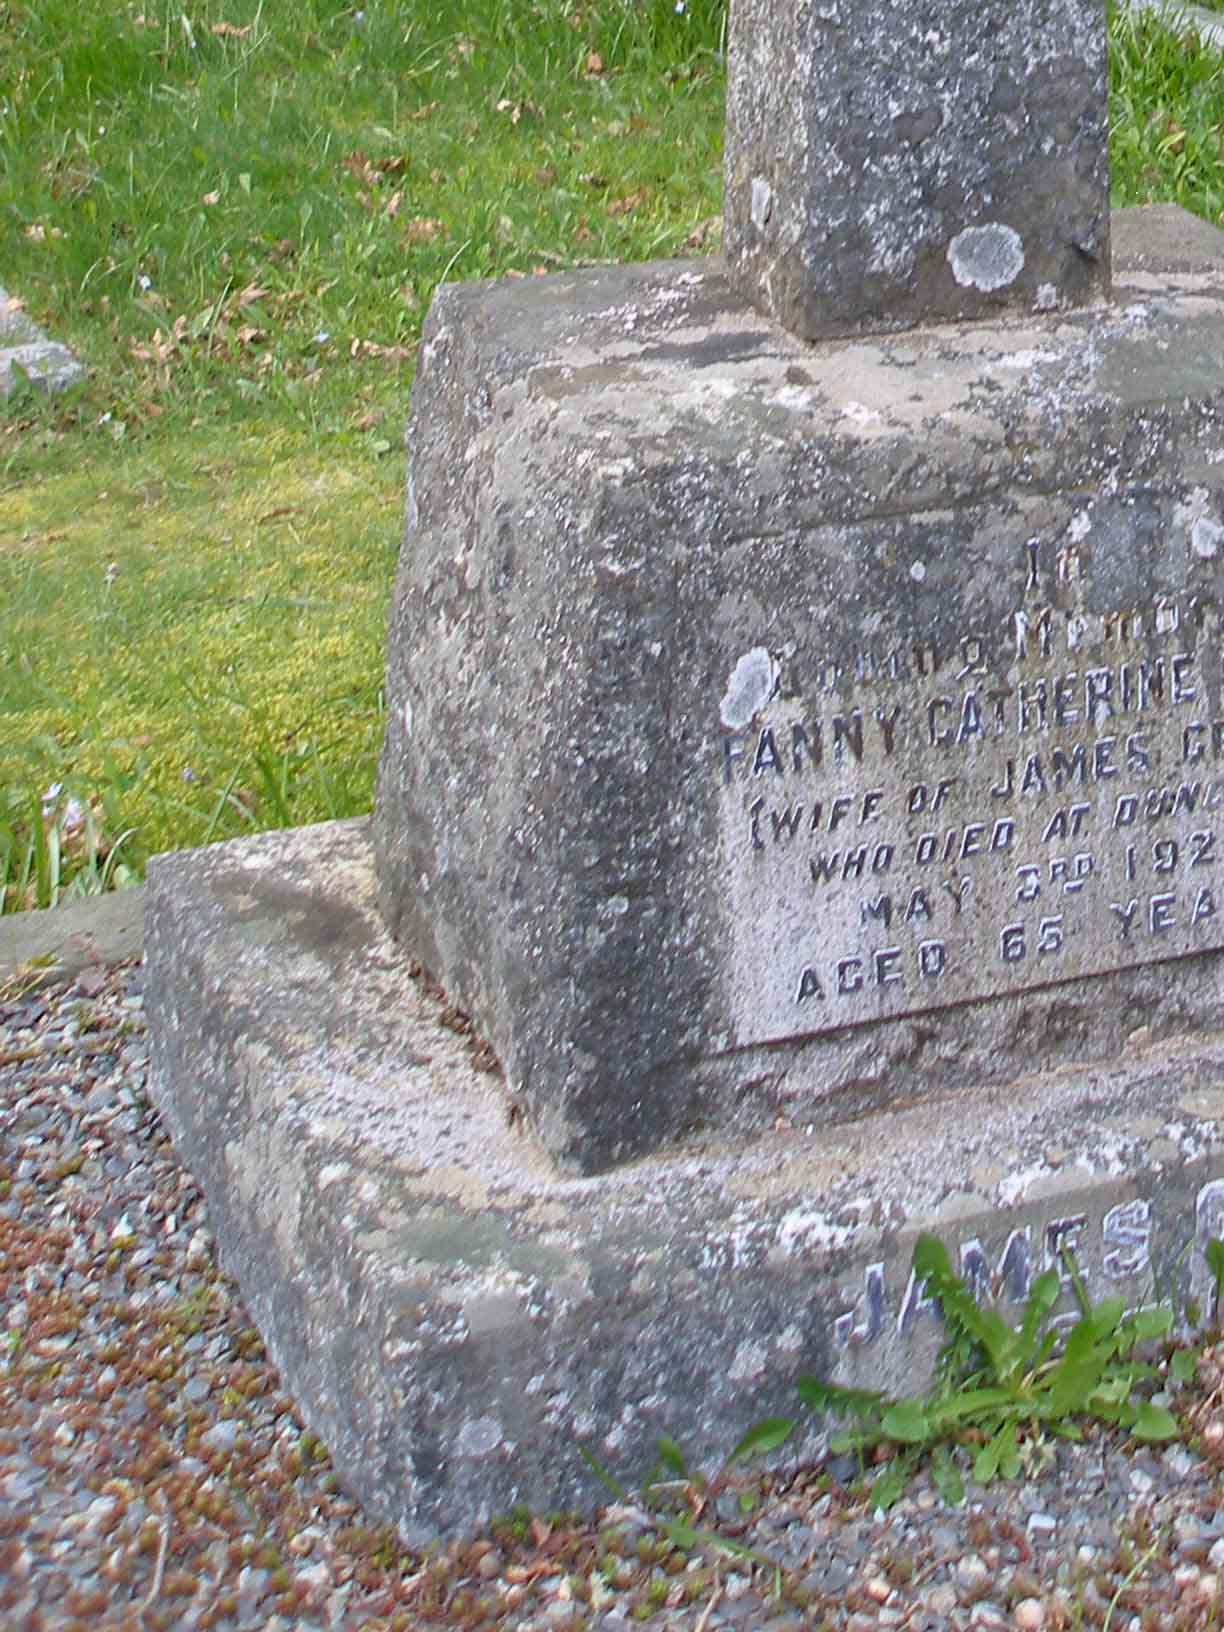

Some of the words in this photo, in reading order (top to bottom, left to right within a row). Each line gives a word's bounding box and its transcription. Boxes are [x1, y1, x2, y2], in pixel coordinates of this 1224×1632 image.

[722, 706, 902, 784] FANNY
[926, 650, 1199, 748] CATHERINE
[907, 775, 958, 815] OF
[990, 730, 1151, 799] JAMES
[808, 842, 896, 883] WHO
[914, 815, 1015, 866] DIED
[1040, 800, 1092, 844] AT
[859, 873, 975, 930] MAY
[1015, 851, 1097, 903] 3RD
[794, 936, 949, 1006] AGED
[1000, 912, 1064, 962] 65
